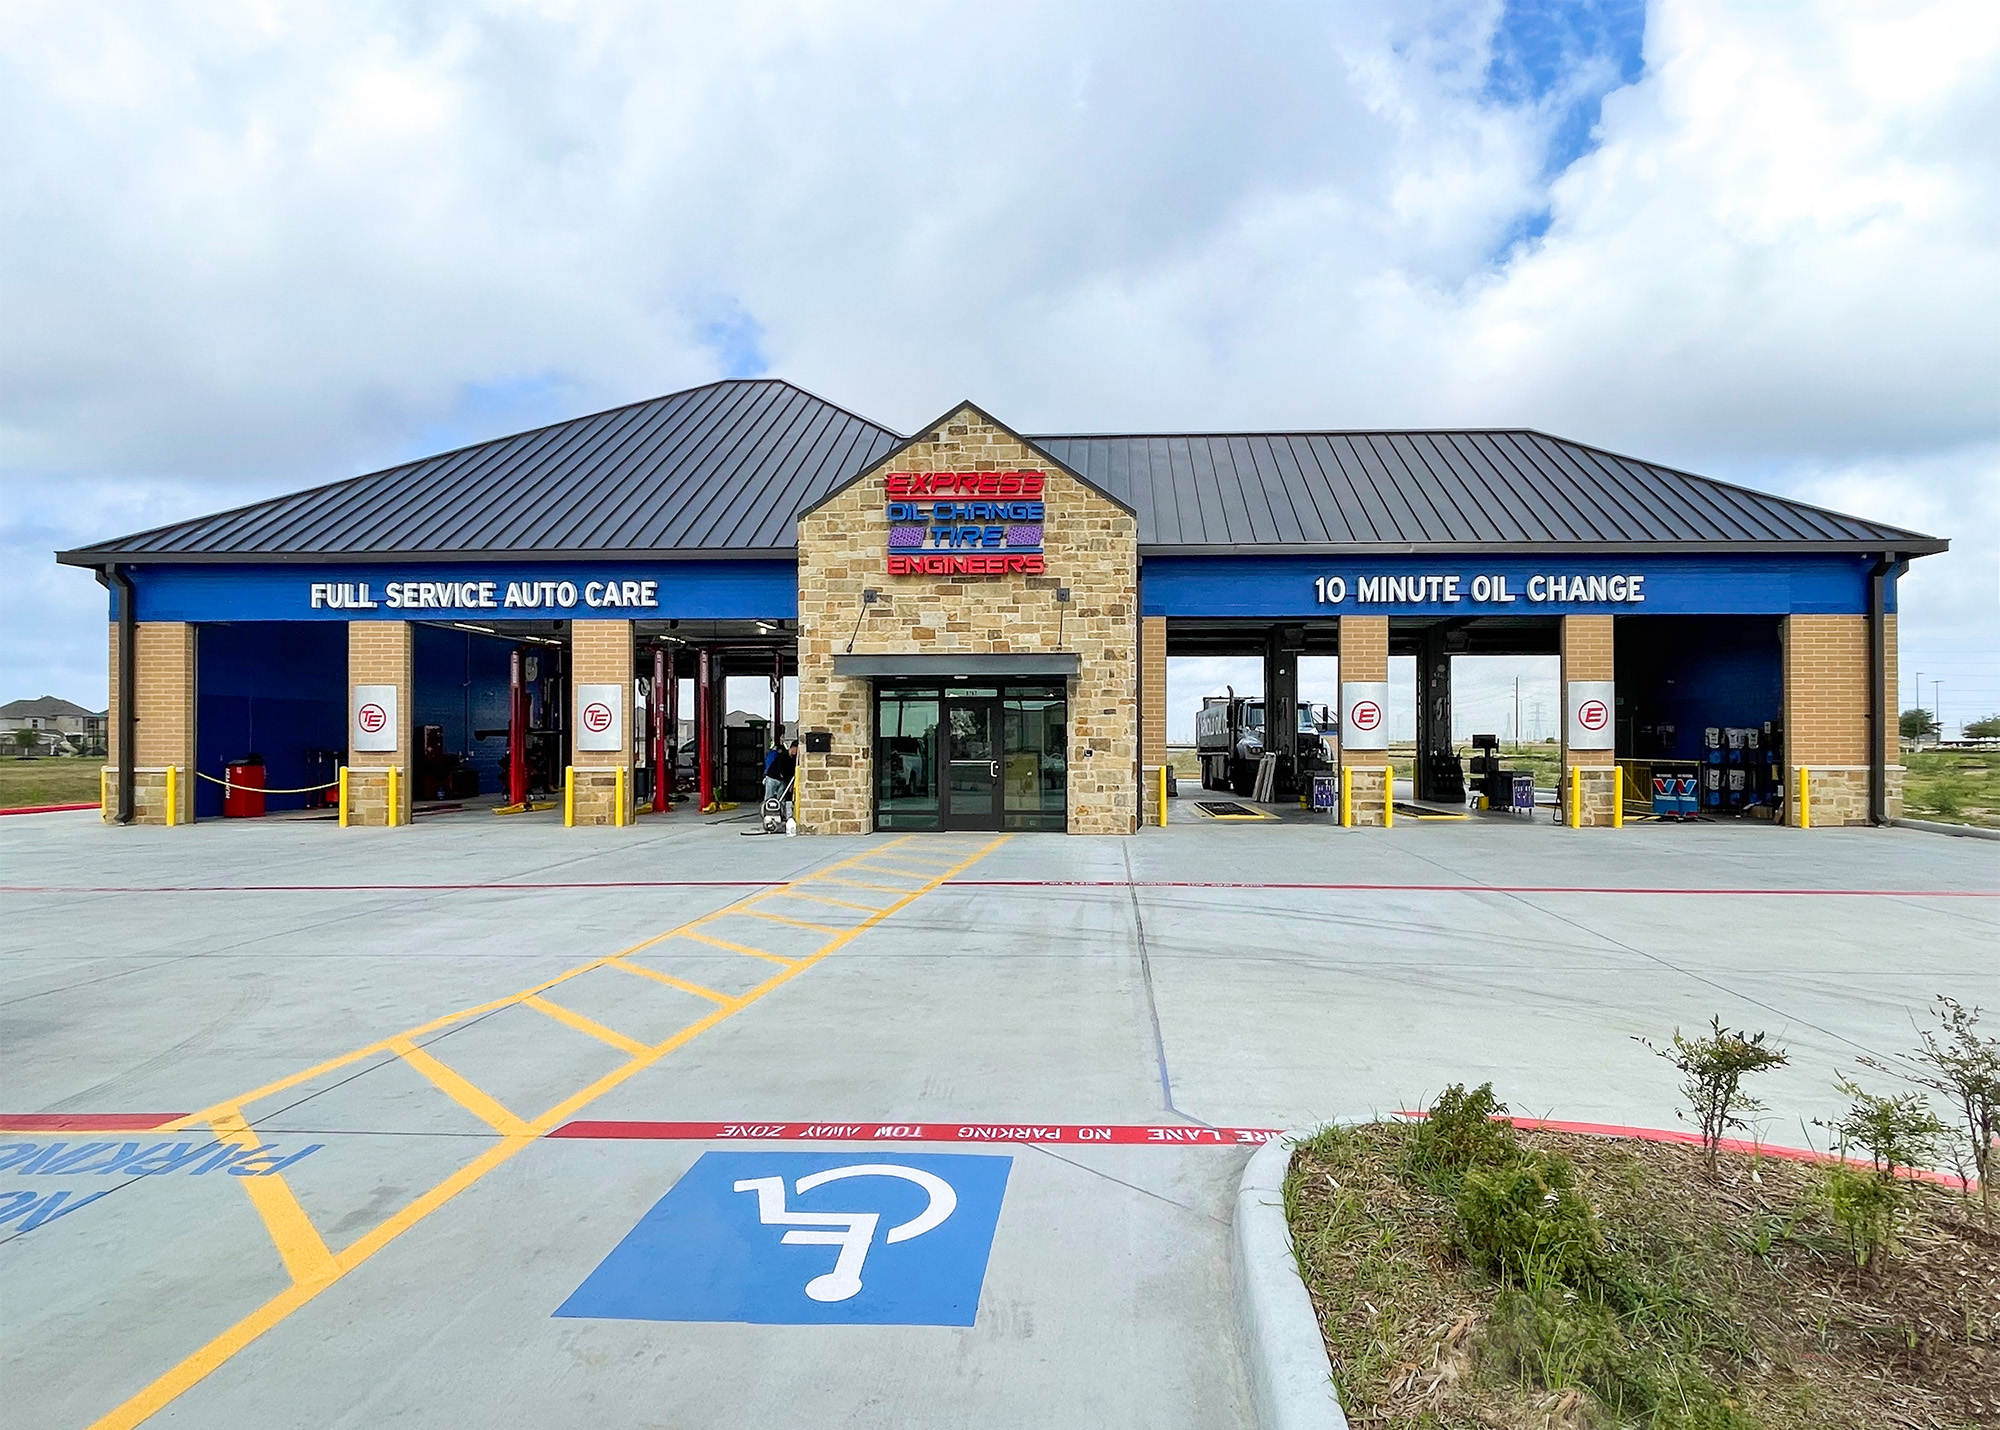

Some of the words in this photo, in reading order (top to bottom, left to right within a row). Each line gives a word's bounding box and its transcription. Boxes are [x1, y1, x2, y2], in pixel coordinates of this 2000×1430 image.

[886, 472, 1045, 494] EXPRESS
[888, 503, 929, 521] OIL
[933, 502, 1044, 521] CHANGE
[930, 525, 1004, 547] TIRE
[888, 555, 1044, 575] ENGINEERS
[311, 583, 377, 608] FULL
[385, 581, 498, 608] SERVICE
[503, 581, 576, 608] AUTO
[584, 581, 659, 608] CARE
[1315, 577, 1346, 603] 10
[1358, 576, 1460, 602] MINUTE
[1471, 576, 1516, 602] OIL
[1527, 575, 1645, 602] CHANGE
[716, 1125, 786, 1137] ZONE
[799, 1125, 862, 1137] AWAY
[873, 1125, 923, 1138] TOW
[957, 1126, 1061, 1140] PARKING
[1078, 1127, 1112, 1140] NO
[1147, 1128, 1221, 1141] LANE
[1234, 1131, 1278, 1142] IRE
